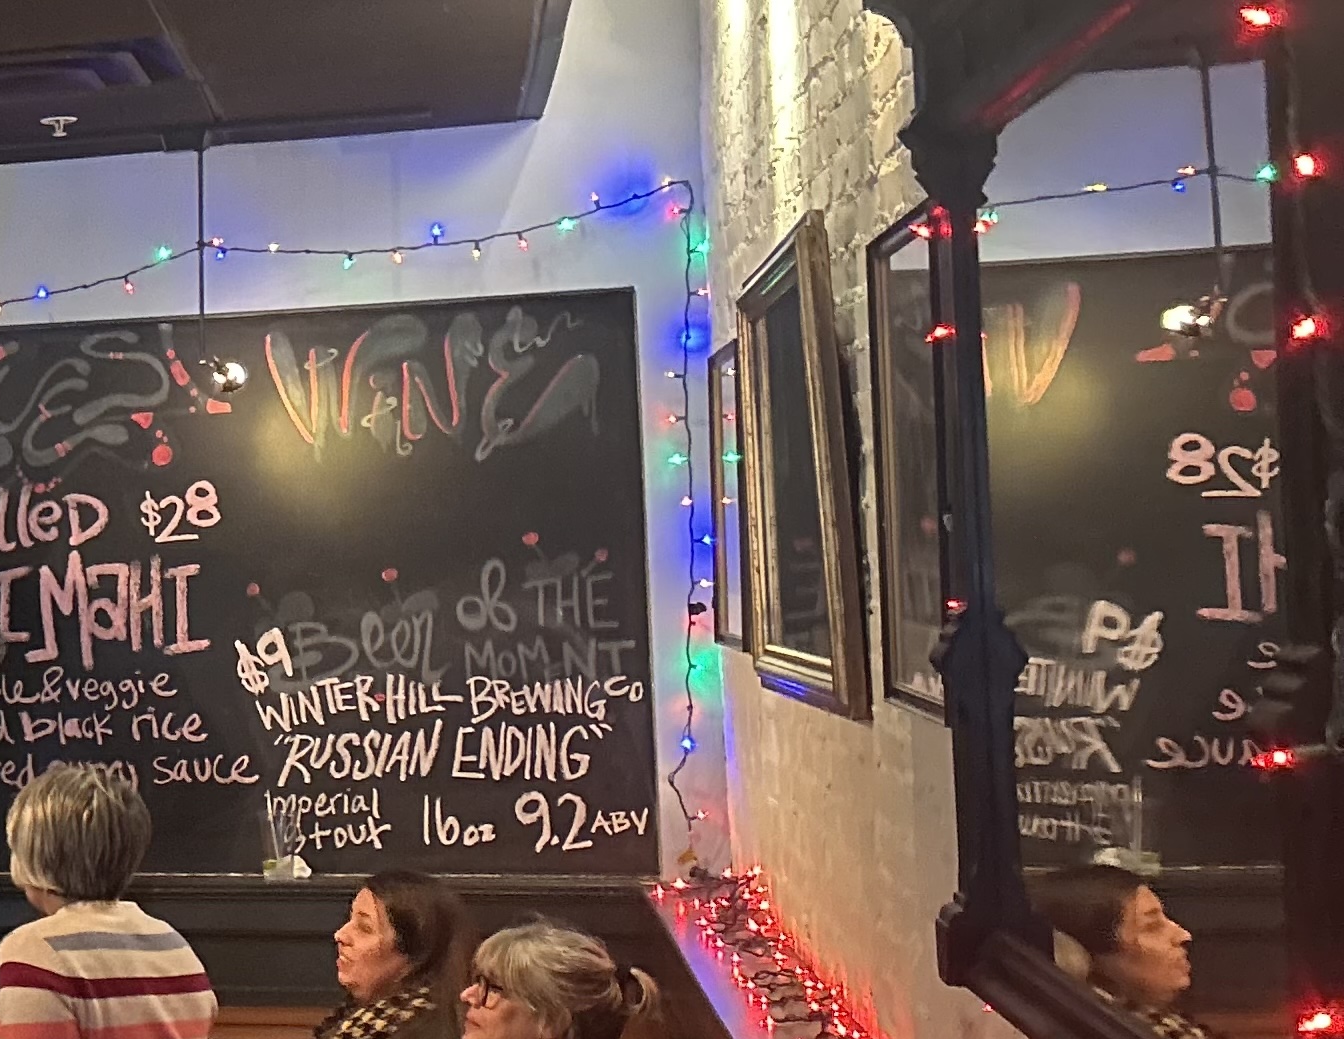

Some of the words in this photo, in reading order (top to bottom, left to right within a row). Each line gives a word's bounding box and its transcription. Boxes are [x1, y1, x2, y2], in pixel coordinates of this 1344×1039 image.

[140, 479, 223, 543] $28
[234, 627, 294, 695] $9
[131, 706, 209, 743] rice
[152, 753, 261, 785] sauce
[589, 807, 650, 836] ABV
